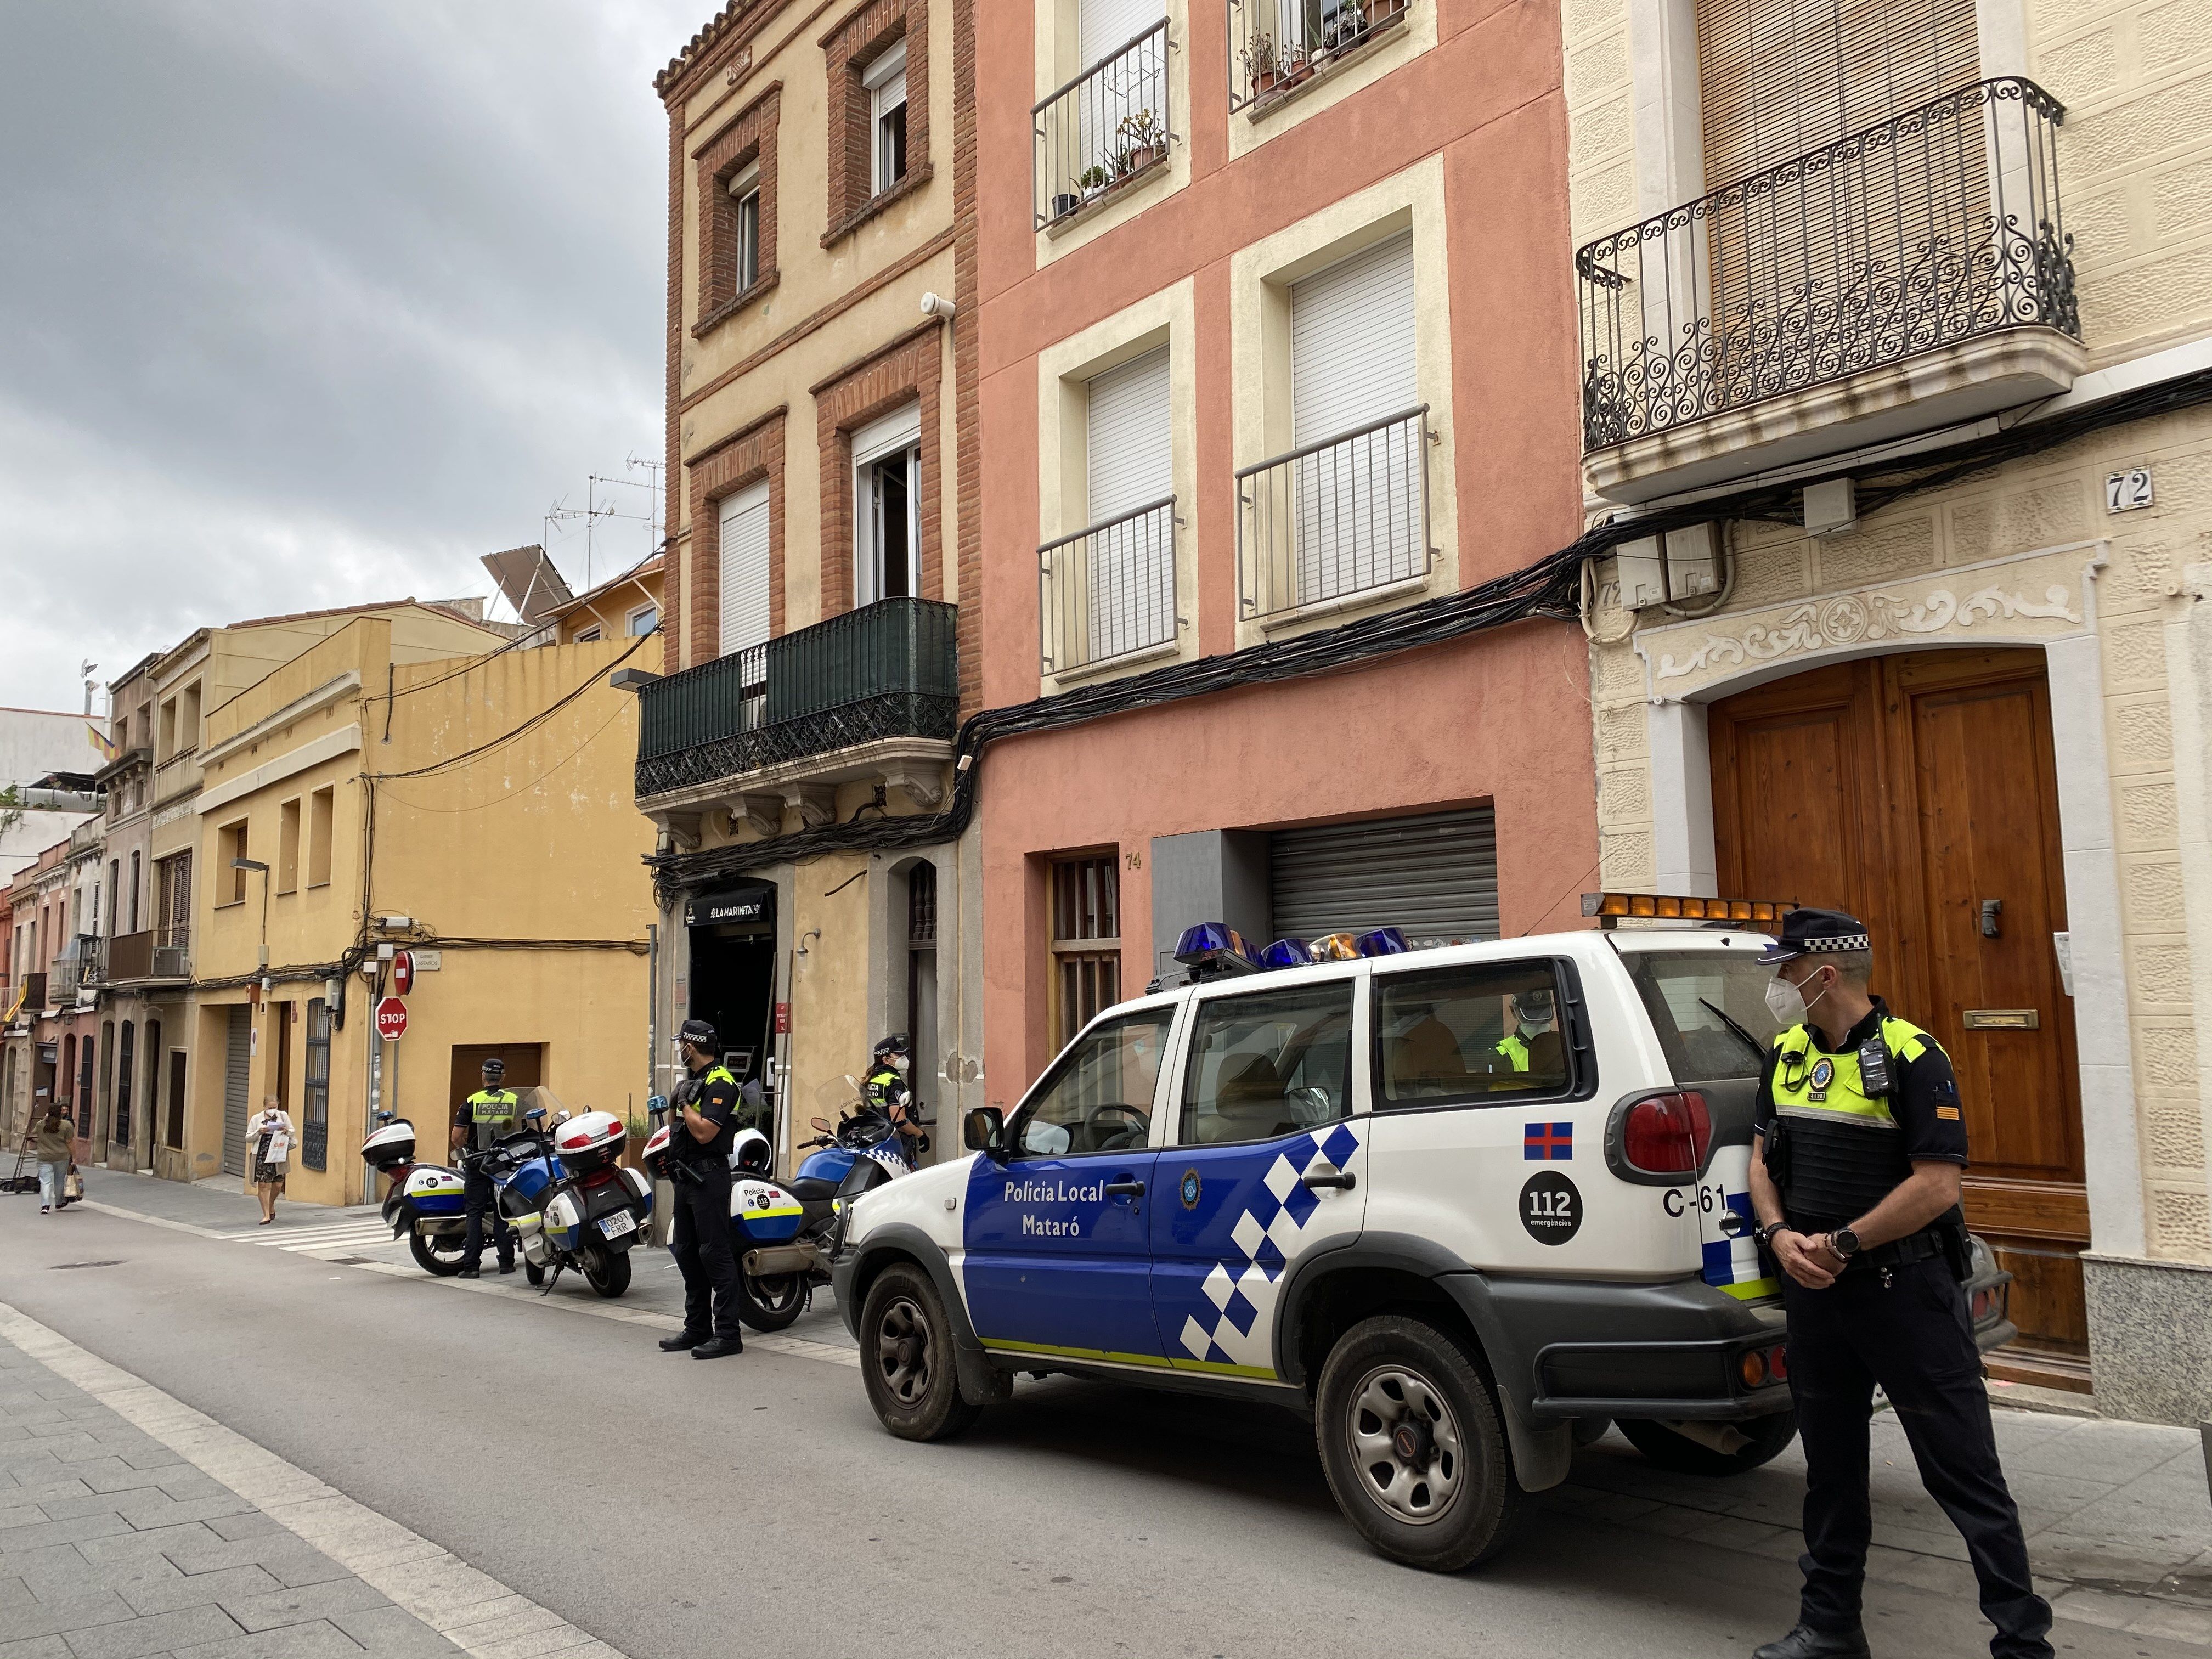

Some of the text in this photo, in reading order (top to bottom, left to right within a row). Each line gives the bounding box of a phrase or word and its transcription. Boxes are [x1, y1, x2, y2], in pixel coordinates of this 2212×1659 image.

[2108, 472, 2150, 507] 72
[1125, 851, 1141, 870] 74
[380, 1013, 405, 1024] STOP
[1005, 1179, 1104, 1202] Policia Local
[1663, 1183, 1726, 1218] C-61
[1529, 1192, 1571, 1216] 112
[606, 1212, 629, 1227] 0201
[610, 1223, 629, 1236] FRR
[1023, 1214, 1080, 1237] Mataró
[1531, 1218, 1572, 1228] emergències
